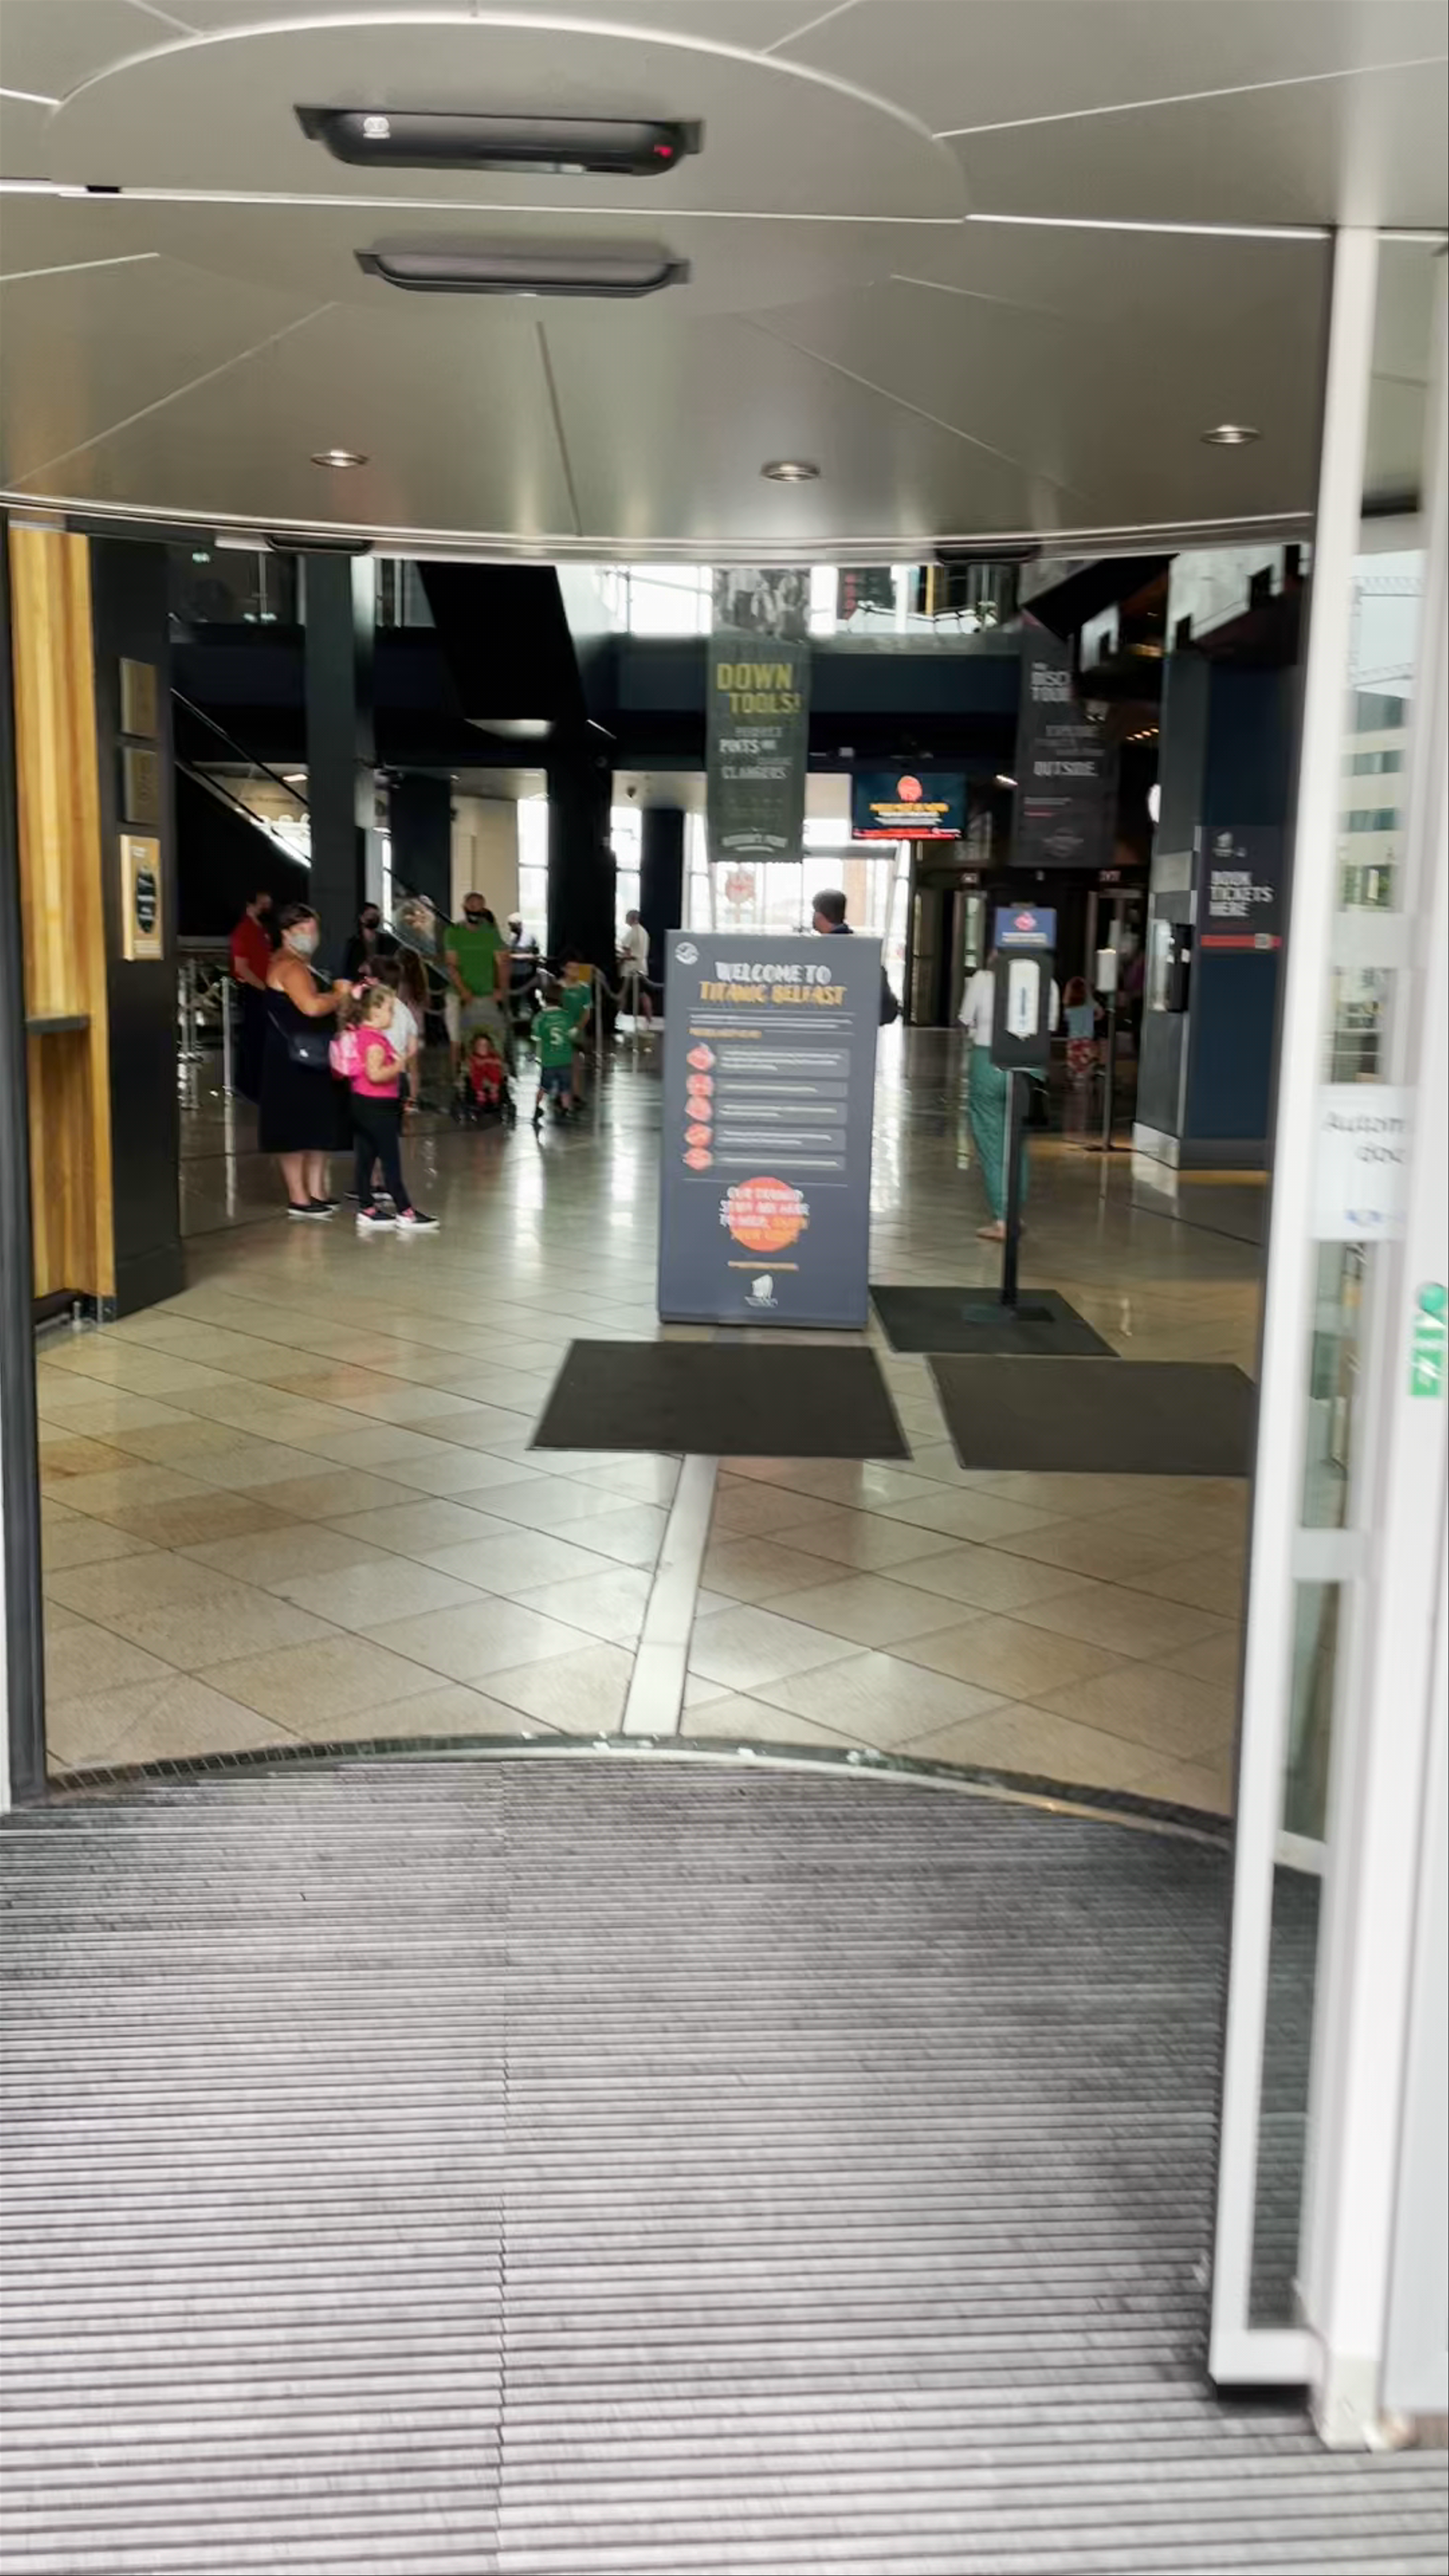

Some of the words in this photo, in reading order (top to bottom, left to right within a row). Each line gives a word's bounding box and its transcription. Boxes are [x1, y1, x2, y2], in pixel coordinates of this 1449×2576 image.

[717, 663, 793, 690] DOWN
[729, 692, 801, 714] TOOLS!
[719, 739, 761, 754] PINTS
[1211, 871, 1252, 886] BOOK
[1210, 885, 1275, 903] TICKETS
[1209, 901, 1251, 917] HERE
[715, 961, 804, 983] WELCOME
[804, 964, 832, 985] TO
[699, 981, 766, 1003] TITANIC
[771, 984, 848, 1006] BELFAST
